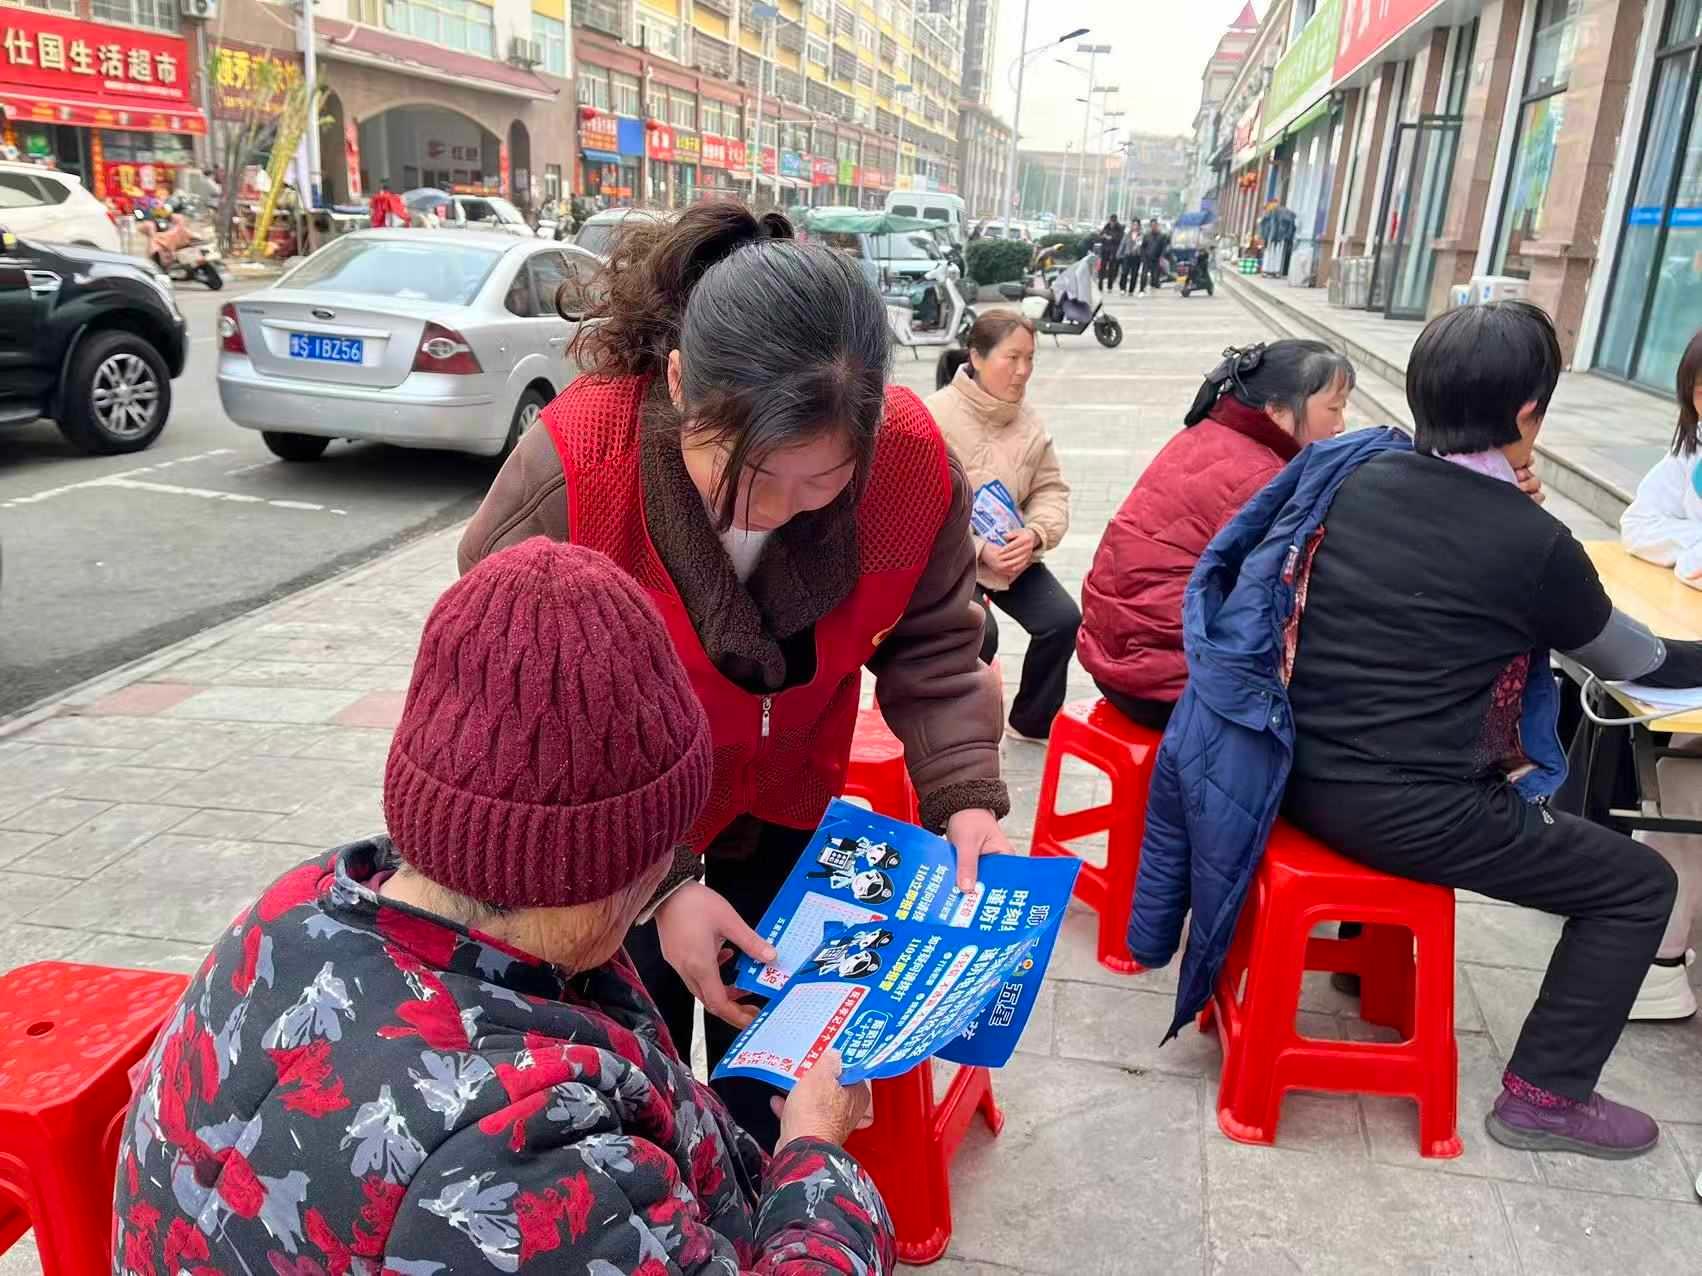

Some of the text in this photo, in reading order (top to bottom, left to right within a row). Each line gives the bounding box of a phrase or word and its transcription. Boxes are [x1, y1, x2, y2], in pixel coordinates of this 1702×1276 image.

[4, 26, 178, 84] 仕国生活超市
[988, 981, 1023, 1028] 五星
